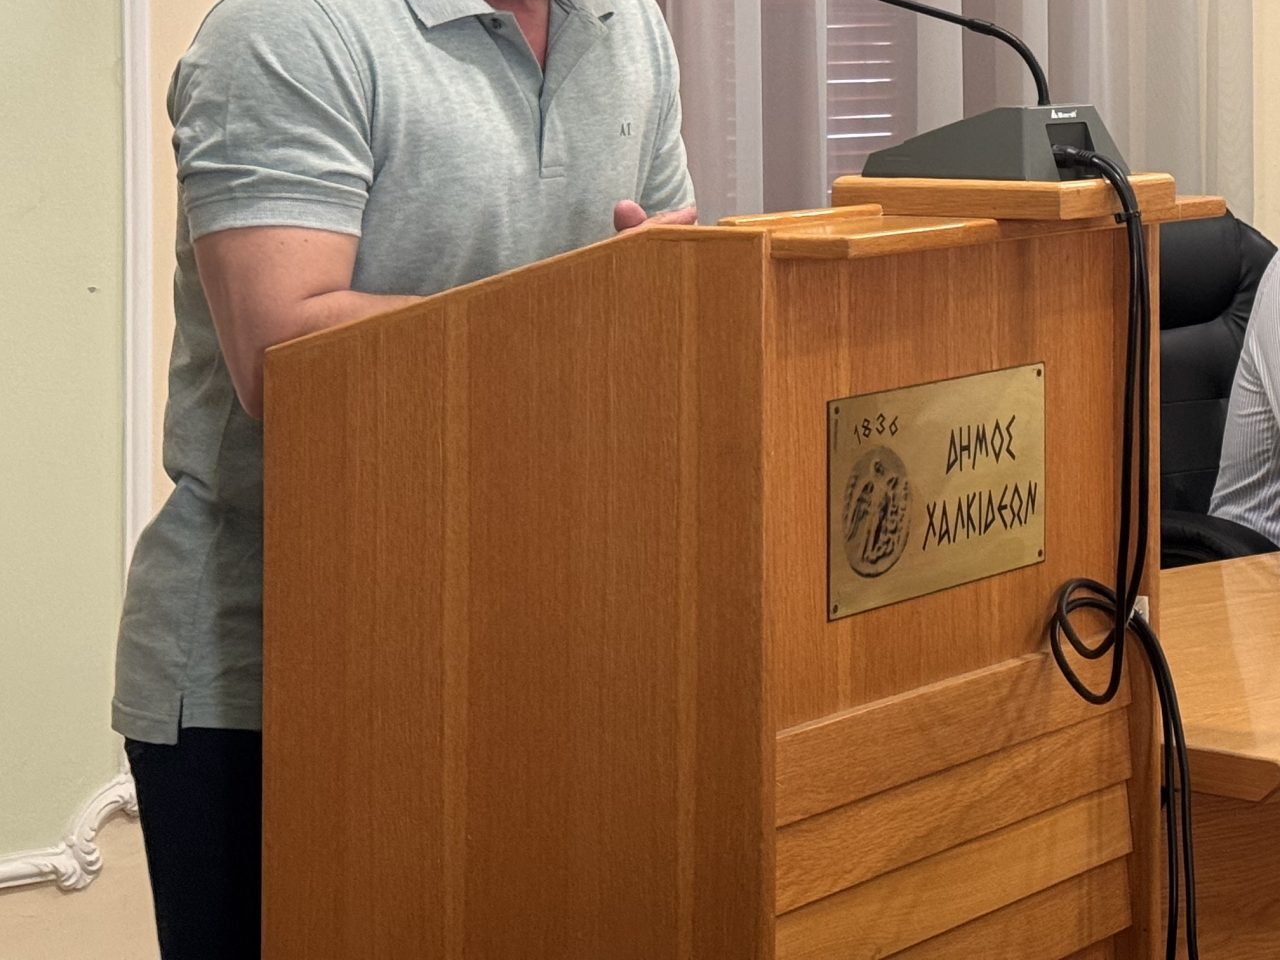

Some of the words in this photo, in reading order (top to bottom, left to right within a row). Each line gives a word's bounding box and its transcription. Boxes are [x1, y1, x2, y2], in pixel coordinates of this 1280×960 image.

[853, 413, 899, 445] 1836
[946, 415, 1016, 475] ΔΗΜΟΣ
[922, 480, 1038, 551] ΧΑΛΚΙΔΕΩΝ
